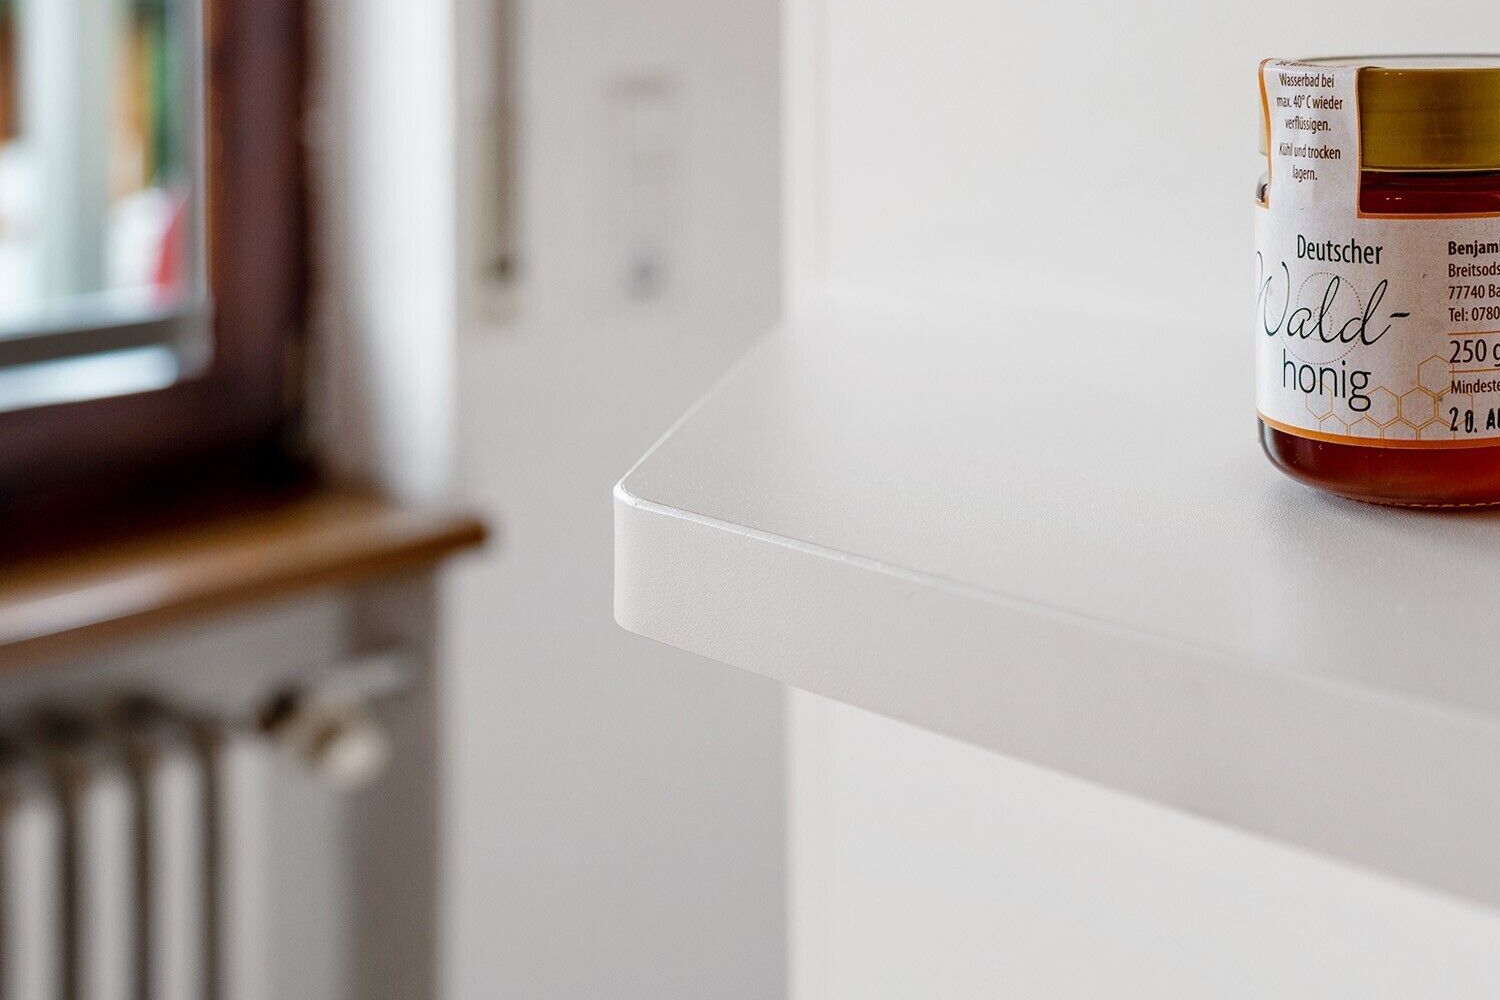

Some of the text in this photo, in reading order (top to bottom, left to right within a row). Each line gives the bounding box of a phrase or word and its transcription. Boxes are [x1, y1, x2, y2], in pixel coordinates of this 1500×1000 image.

[1279, 73, 1335, 88] Wasserbad bei
[1312, 96, 1343, 110] wieder
[1285, 116, 1331, 134] verflüssigen.
[1294, 144, 1307, 157] und
[1308, 145, 1341, 159] trocken
[1293, 165, 1317, 182] lagern.
[1297, 234, 1383, 264] Deutscher
[1256, 250, 1411, 345] Wald-
[1448, 284, 1485, 299] 77740
[1448, 307, 1468, 322] Tel:
[1450, 339, 1487, 364] 250
[1283, 348, 1372, 413] honig
